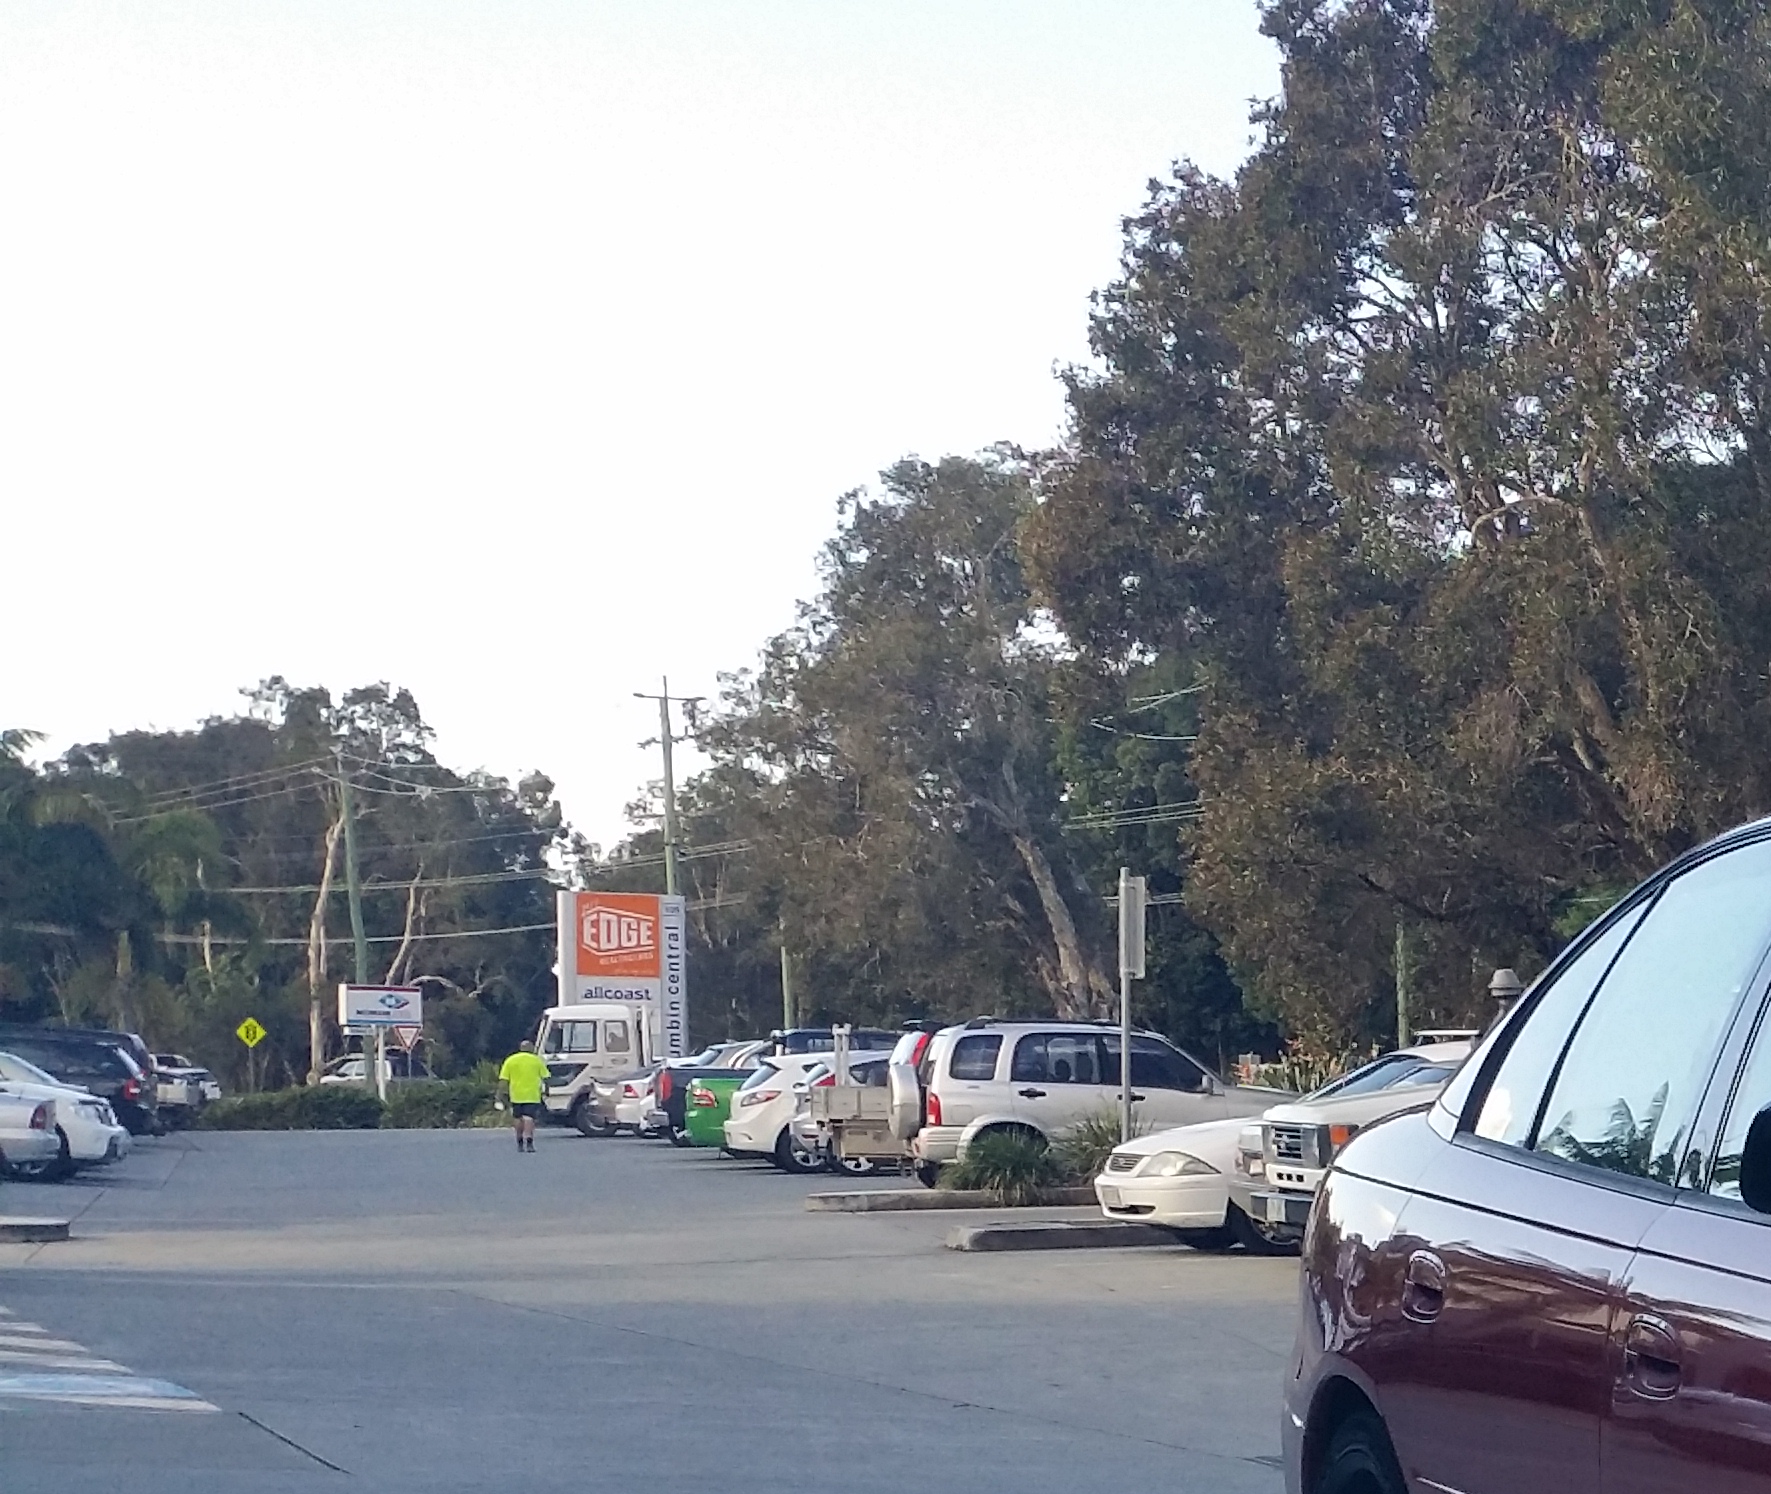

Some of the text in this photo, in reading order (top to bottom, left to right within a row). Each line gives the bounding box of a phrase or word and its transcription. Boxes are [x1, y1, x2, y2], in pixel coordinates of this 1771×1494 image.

[583, 912, 655, 950] EDGE
[664, 926, 680, 995] central
[584, 987, 652, 1001] allcoast
